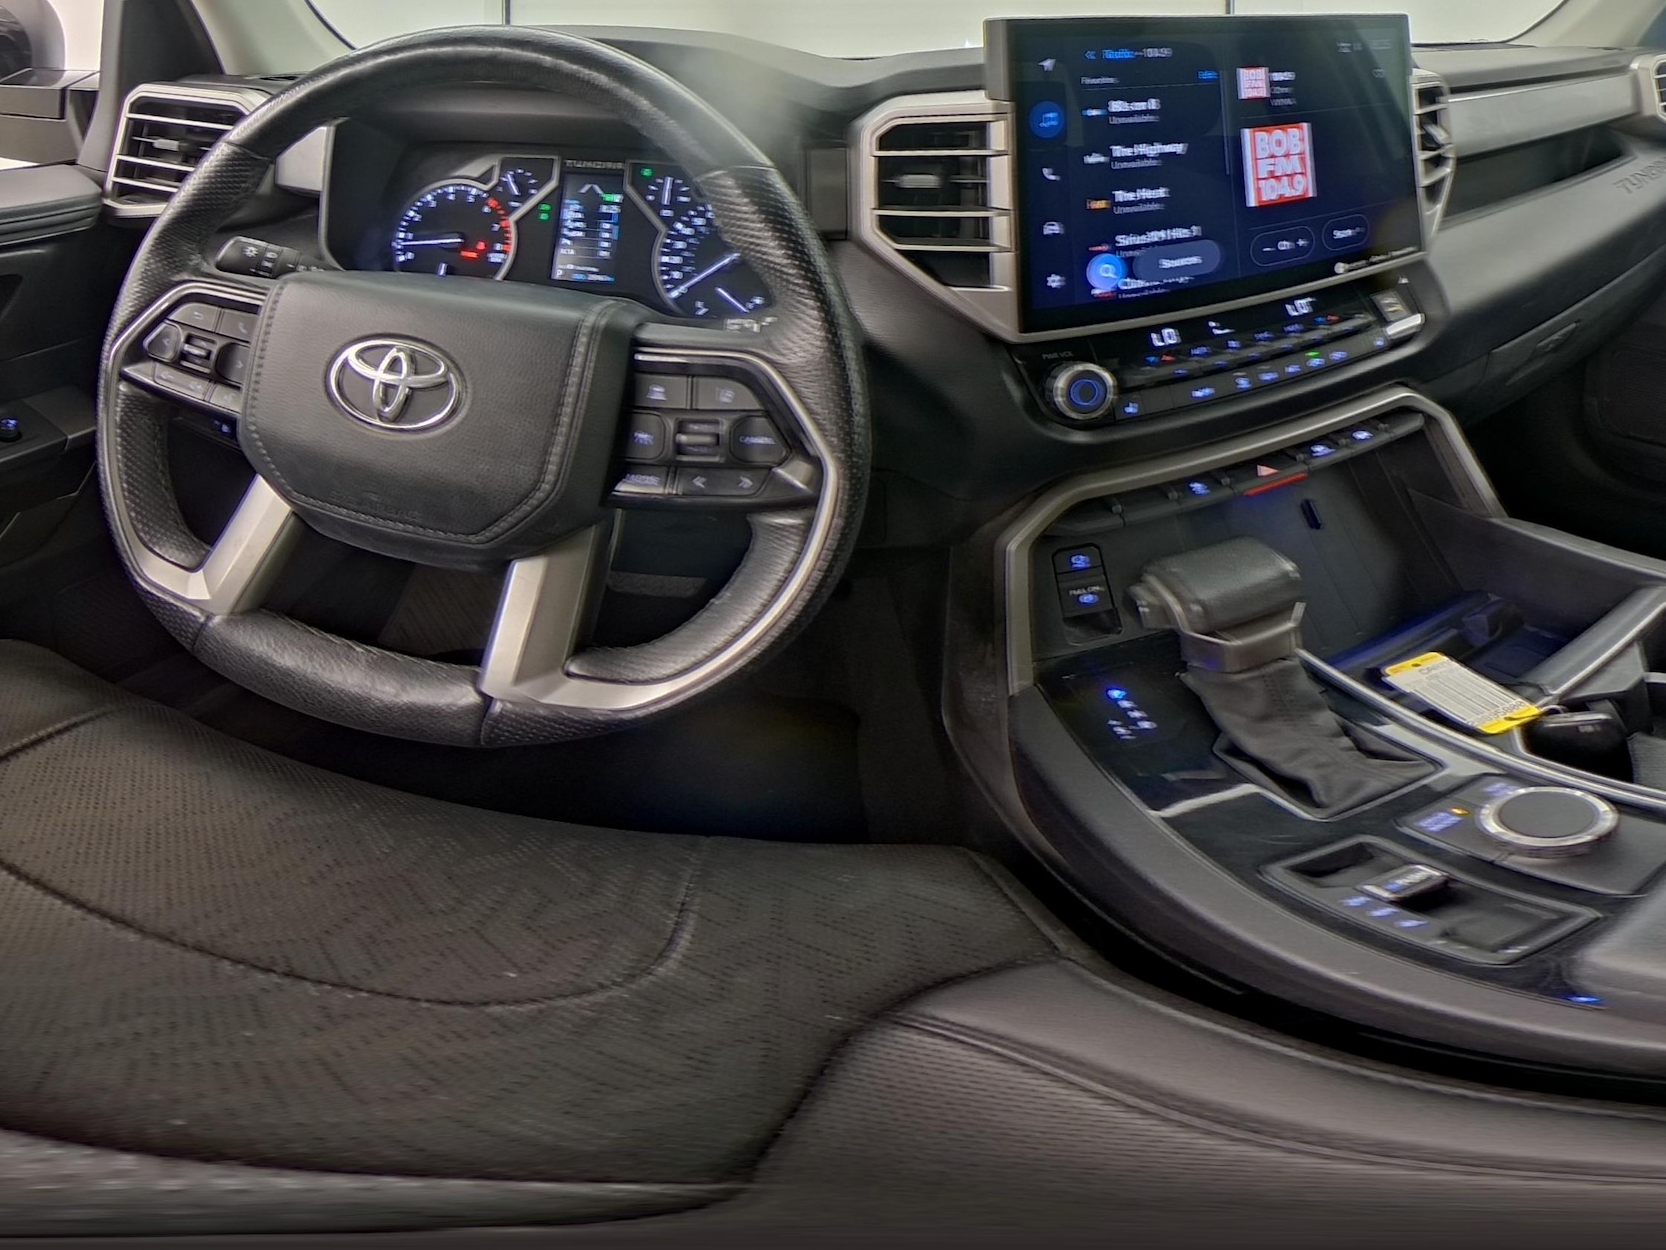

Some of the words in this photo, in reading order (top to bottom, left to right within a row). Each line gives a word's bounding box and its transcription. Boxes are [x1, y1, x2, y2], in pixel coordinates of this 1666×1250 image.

[1255, 128, 1302, 158] BOB
[1257, 158, 1302, 178] FM
[1258, 176, 1306, 201] 104.9
